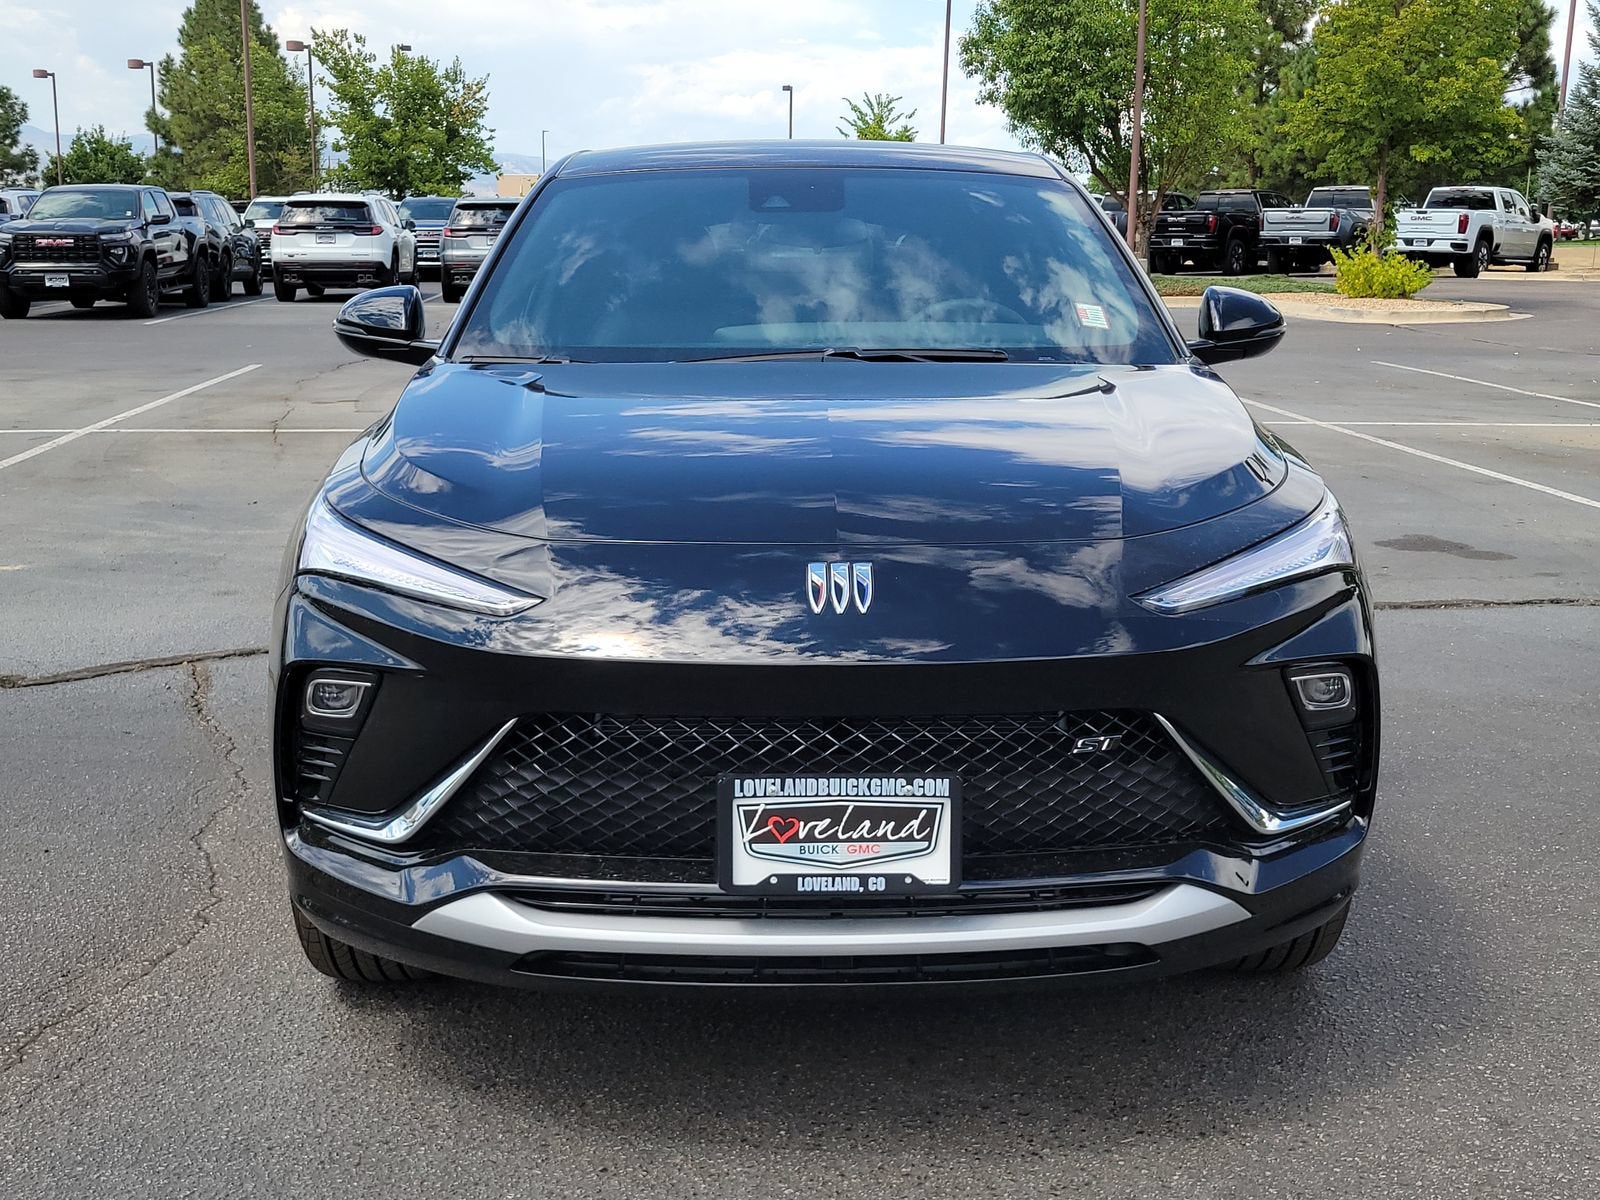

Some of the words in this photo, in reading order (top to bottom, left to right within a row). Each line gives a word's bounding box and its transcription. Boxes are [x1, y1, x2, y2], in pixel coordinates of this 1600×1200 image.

[35, 238, 75, 247] GMC
[734, 778, 950, 797] LOVELANDBUICKGMCCOM
[799, 844, 840, 855] BUICK
[846, 844, 881, 854] GMC
[797, 876, 864, 893] LOVELAND,
[867, 876, 886, 892] CO
